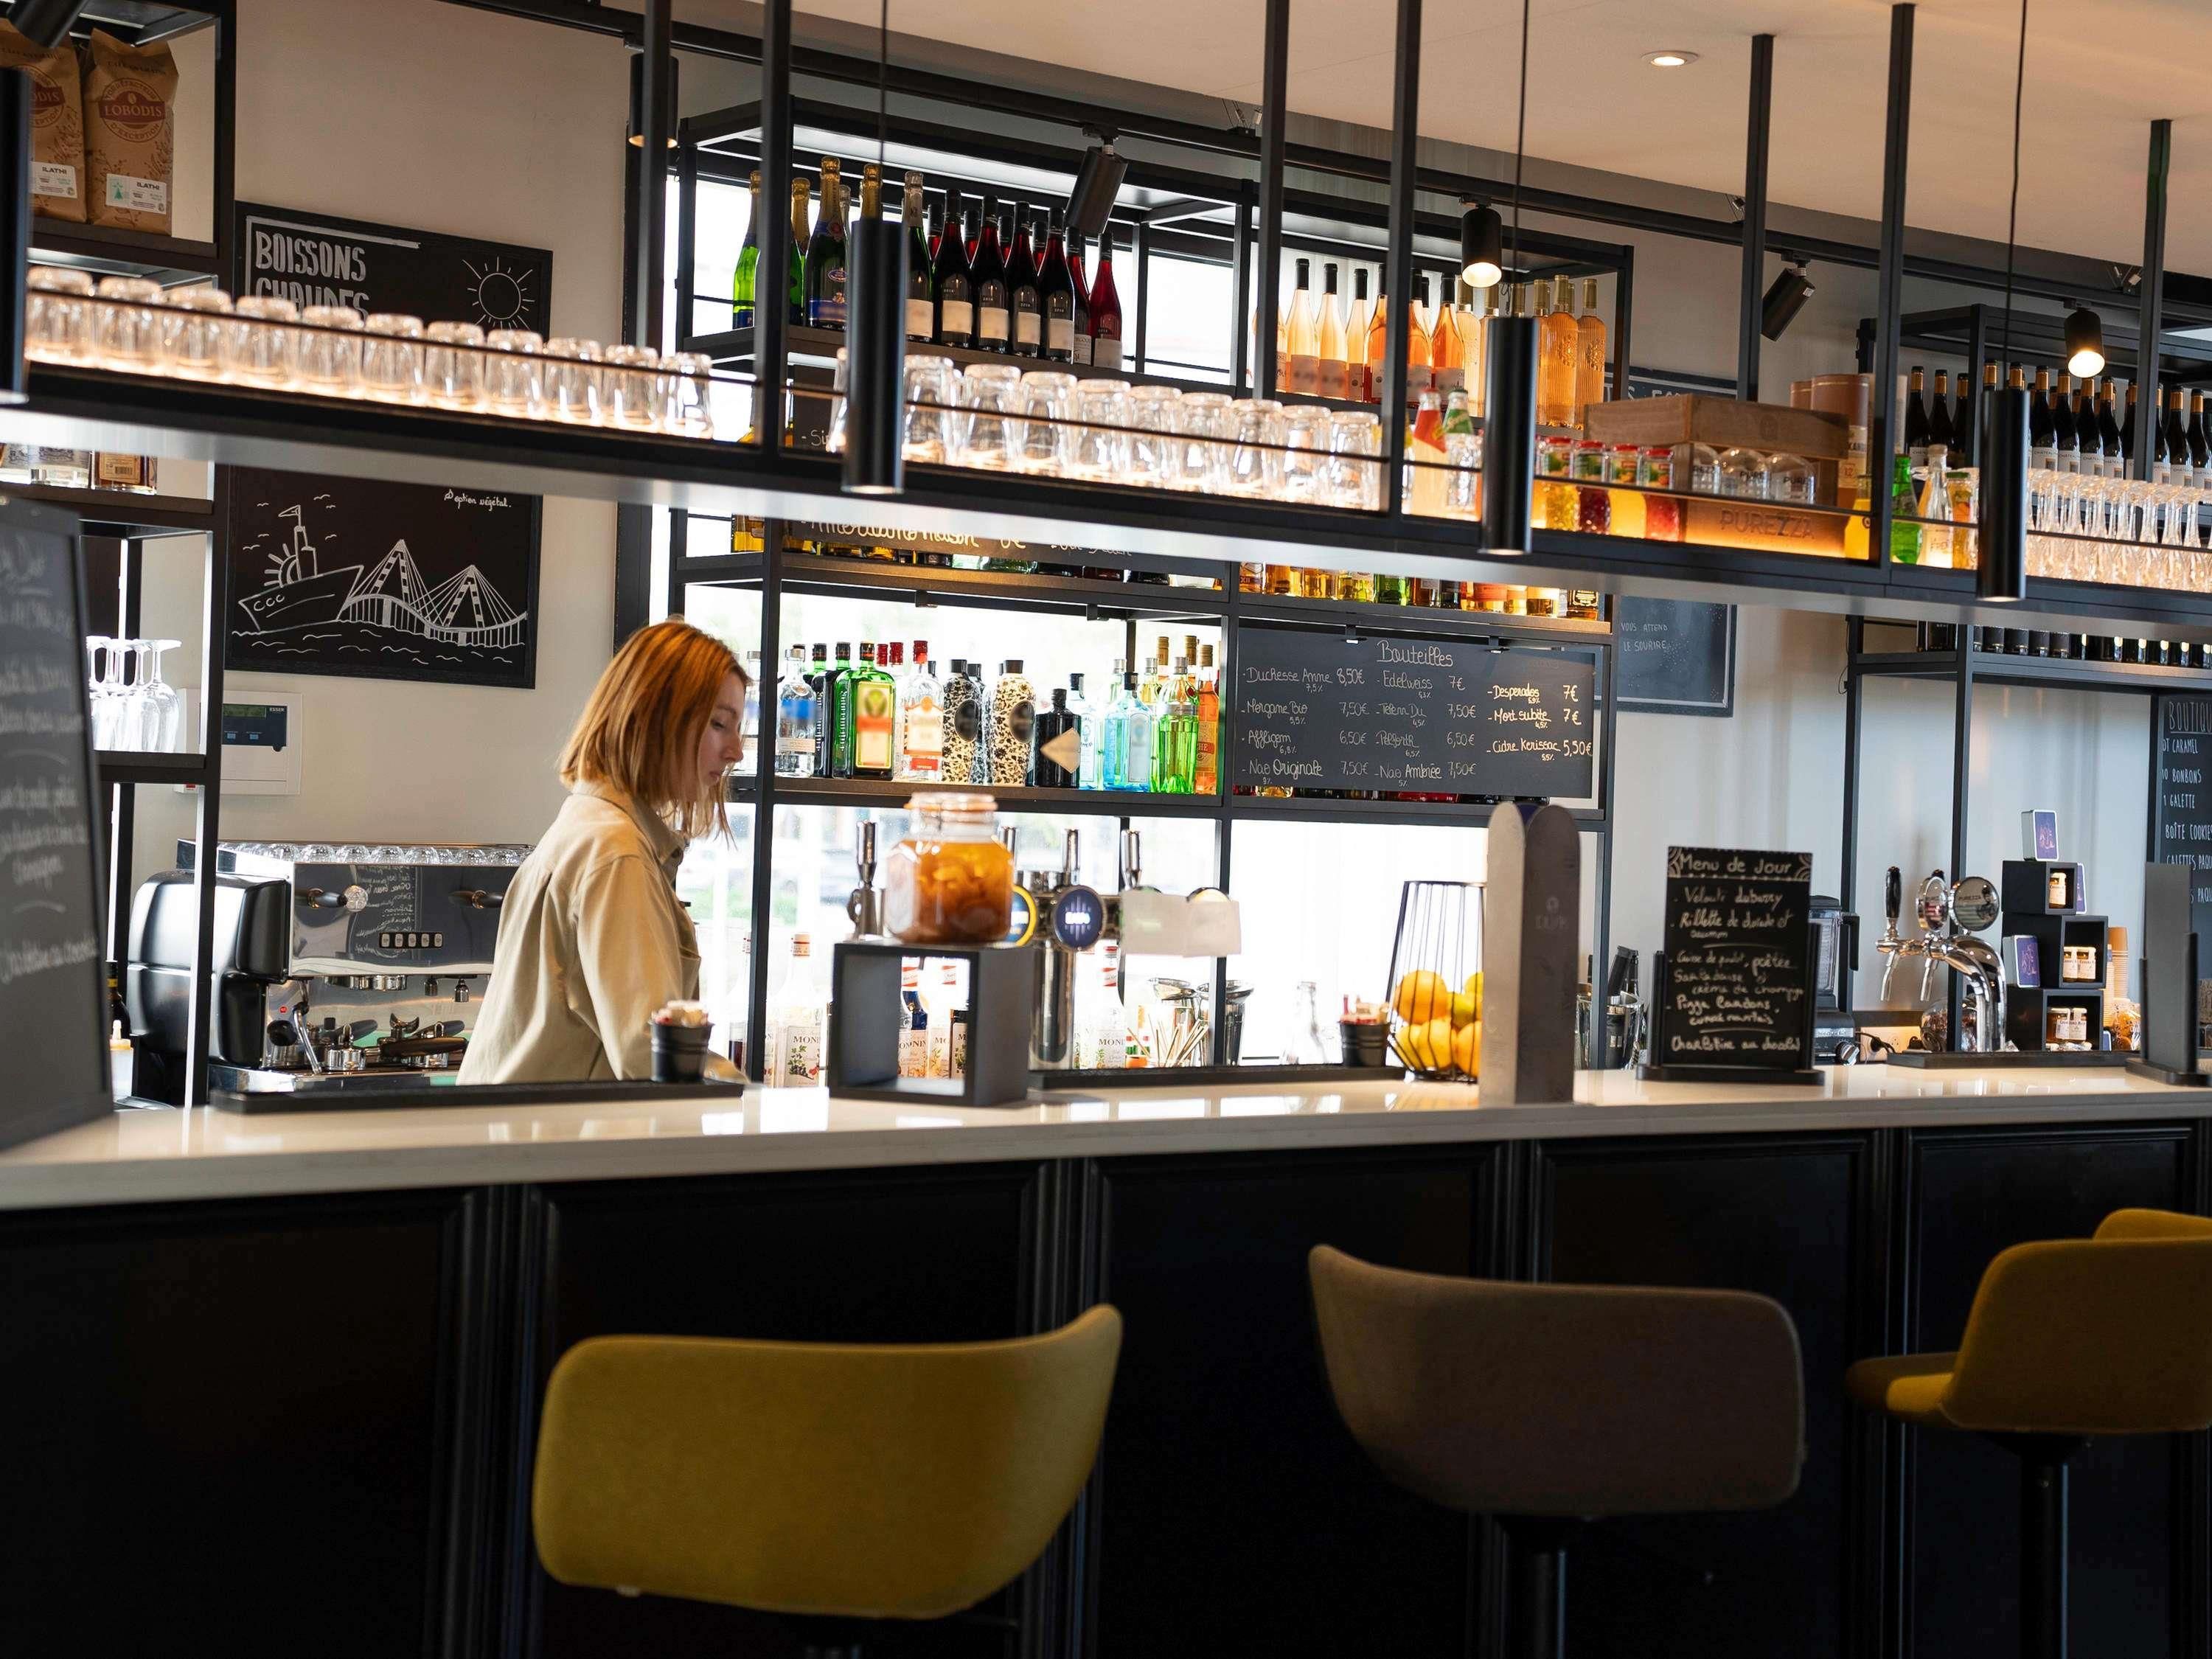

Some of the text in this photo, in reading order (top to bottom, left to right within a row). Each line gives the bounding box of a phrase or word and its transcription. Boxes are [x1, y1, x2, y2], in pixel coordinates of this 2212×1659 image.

[104, 105, 162, 117] LOBODIS
[255, 230, 366, 282] BOISSONS
[1720, 509, 1815, 540] PUREZZA
[1621, 622, 1638, 632] VOUS
[1376, 639, 1454, 667] Bouteilles
[1624, 641, 1632, 652] LE
[1246, 667, 1366, 686] Duchesse Anne 8,50€
[1382, 669, 1466, 691] Edelweiss 7€
[1492, 683, 1579, 702] Desperados 7€
[1290, 700, 1309, 714] Bio
[1338, 701, 1370, 717] 7,50€
[1447, 703, 1477, 718] 7,50€
[1494, 707, 1518, 724] Mort
[1248, 729, 1367, 749] Affligem 6,50€
[1447, 731, 1475, 748] 6,50€
[1492, 737, 1593, 757] Cidre Kerissac 5,50€
[2172, 738, 2198, 754] CARAMEL
[1249, 759, 1369, 780] Nao Originale 7,50€
[1380, 765, 1402, 779] Nao
[1447, 761, 1478, 779] 7,50€
[2172, 768, 2202, 785] BONBONS
[2170, 794, 2195, 809] GALETTE
[2166, 822, 2185, 840] BOÎTE
[1680, 853, 1719, 872] Menu
